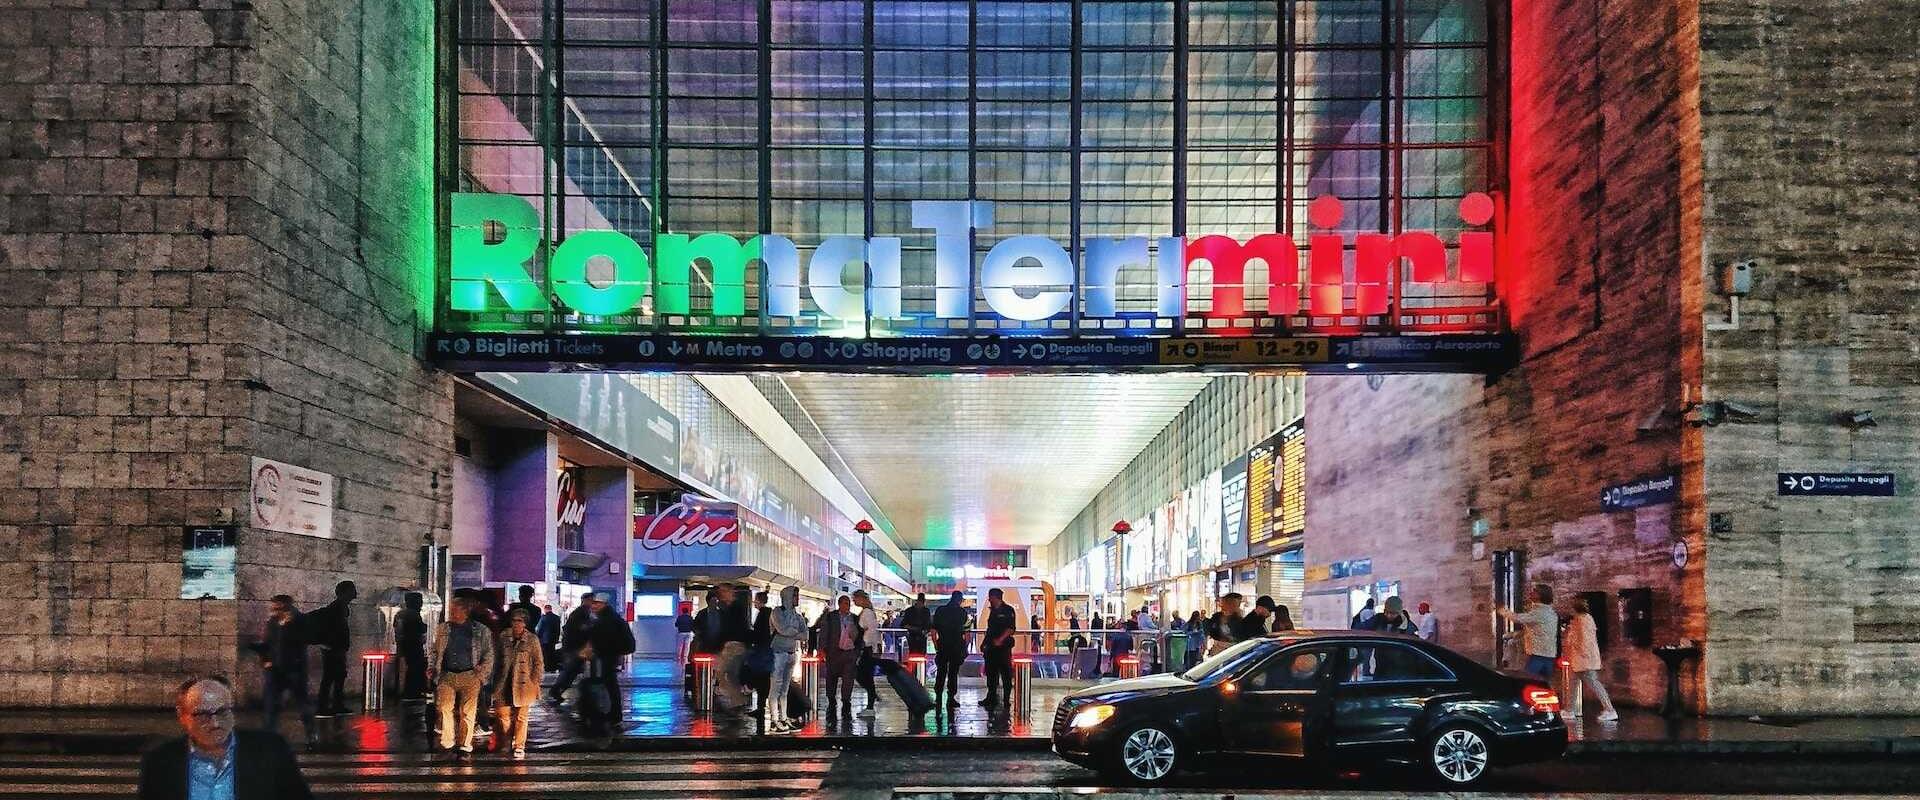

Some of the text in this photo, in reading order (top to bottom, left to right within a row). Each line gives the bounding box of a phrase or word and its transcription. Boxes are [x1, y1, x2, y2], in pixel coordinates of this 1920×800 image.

[476, 337, 604, 357] Biglietti Tickets
[706, 341, 763, 356] Metro
[862, 343, 950, 361] Shopping
[1050, 342, 1153, 355] Deposito Bagagli
[1203, 341, 1239, 351] Binari
[1435, 341, 1500, 352] Aeroporto
[1819, 475, 1889, 485] Deposito Bagagli
[556, 471, 587, 527] Ciao
[643, 502, 737, 549] Ciao
[927, 565, 964, 579] Rom
